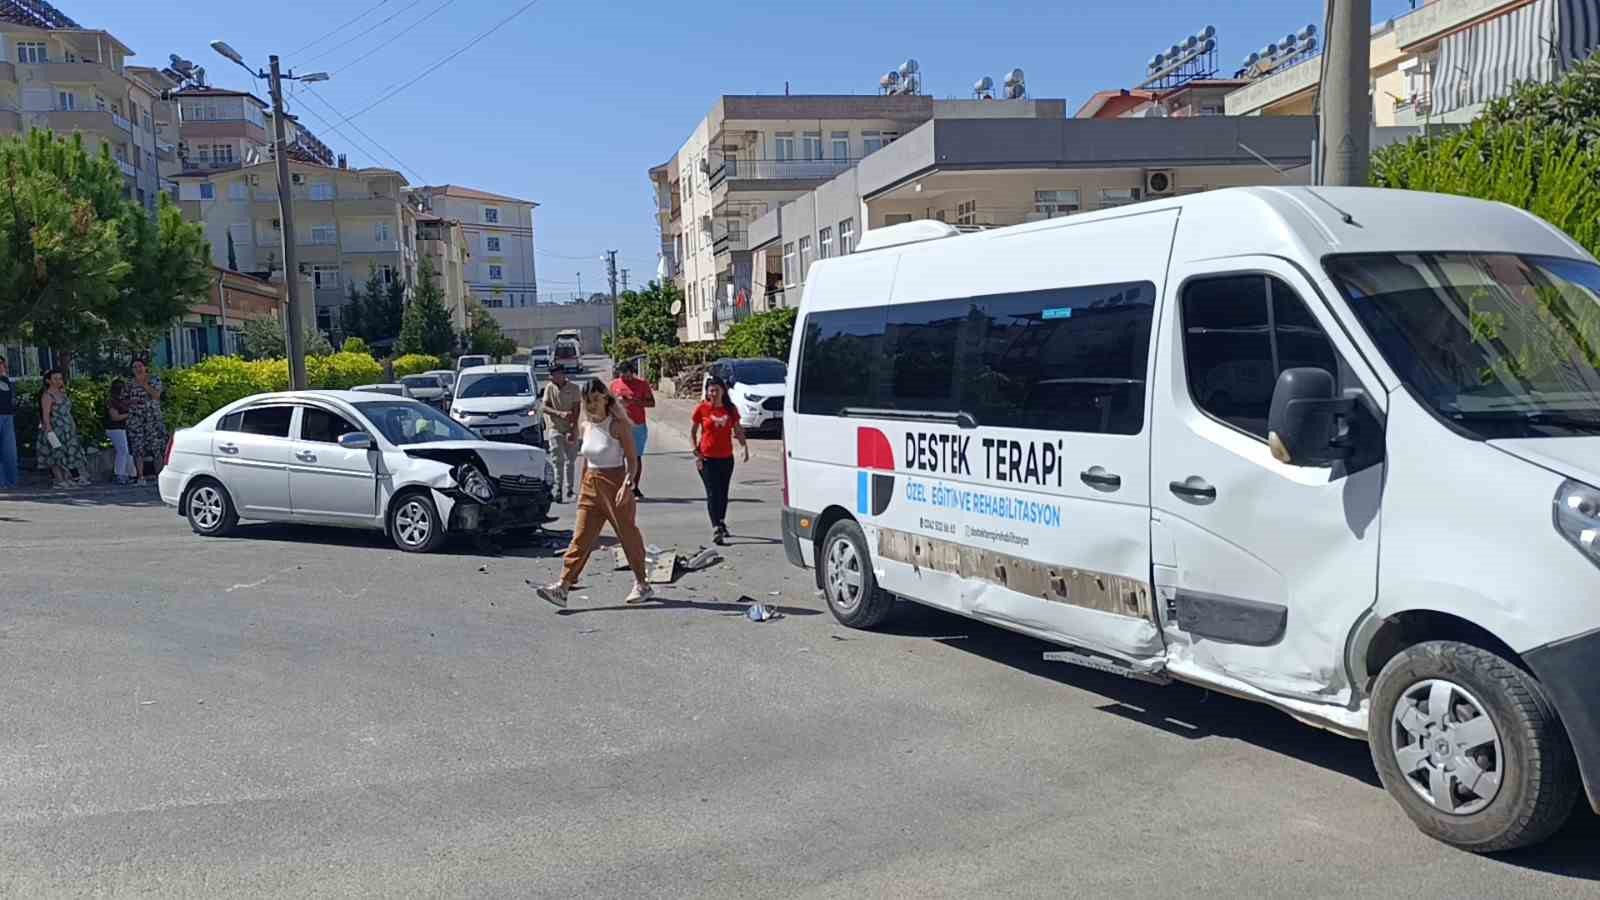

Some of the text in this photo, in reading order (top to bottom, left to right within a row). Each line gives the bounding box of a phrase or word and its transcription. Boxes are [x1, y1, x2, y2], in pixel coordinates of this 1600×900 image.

[905, 432, 971, 476] DESTEK
[905, 478, 927, 503] ÖZEL
[959, 490, 971, 512] VE
[972, 492, 1061, 527] REHABİLİTASYON
